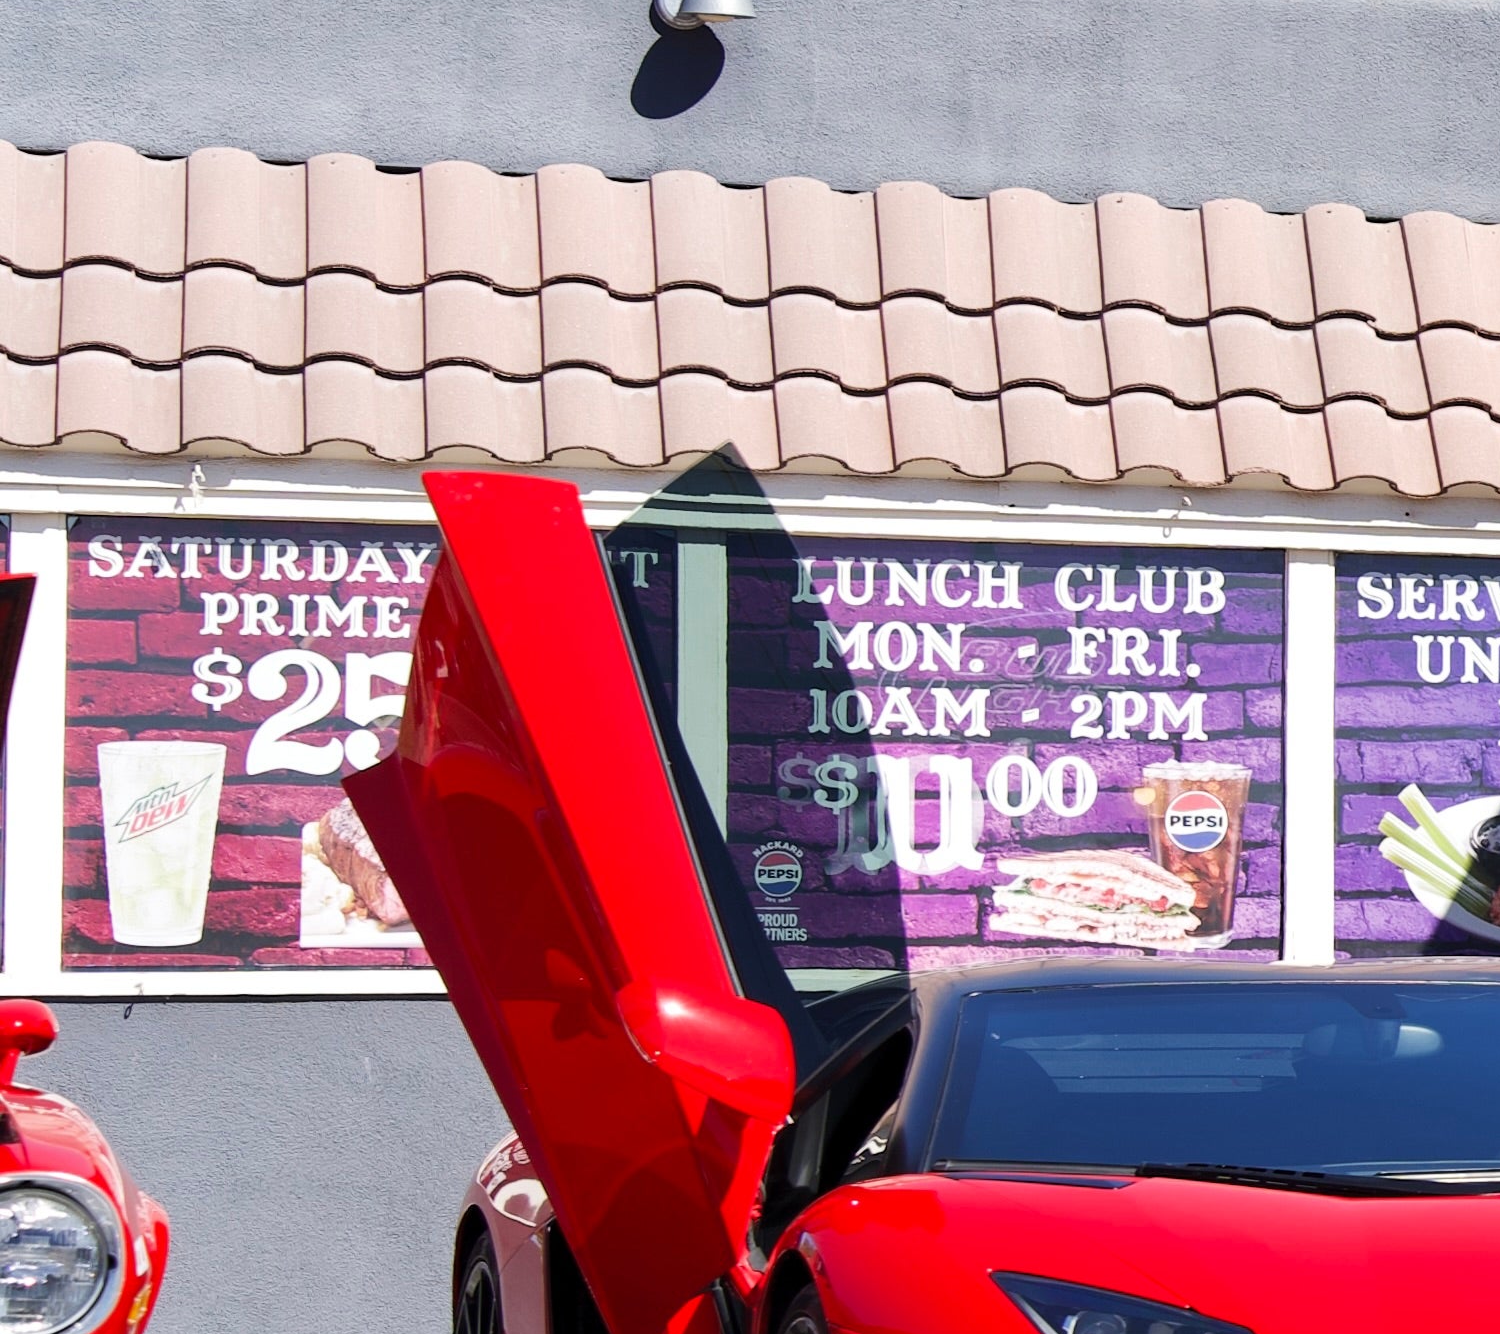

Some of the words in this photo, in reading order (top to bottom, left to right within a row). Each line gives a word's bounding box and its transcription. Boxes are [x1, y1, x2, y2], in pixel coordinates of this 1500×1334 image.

[87, 534, 437, 585] SATURDAY
[792, 556, 1023, 610] LUNCH
[1054, 562, 1227, 615] CLUB
[199, 591, 411, 639] PRIME
[813, 620, 984, 674] MON.
[1066, 626, 1202, 678] FRI.
[807, 686, 991, 738] 10AM
[1070, 691, 1208, 741] 2PM
[1169, 814, 1226, 831] PEPSI
[752, 841, 804, 858] NACKARD
[758, 869, 799, 879] PEPSI
[757, 913, 798, 927] PROUD
